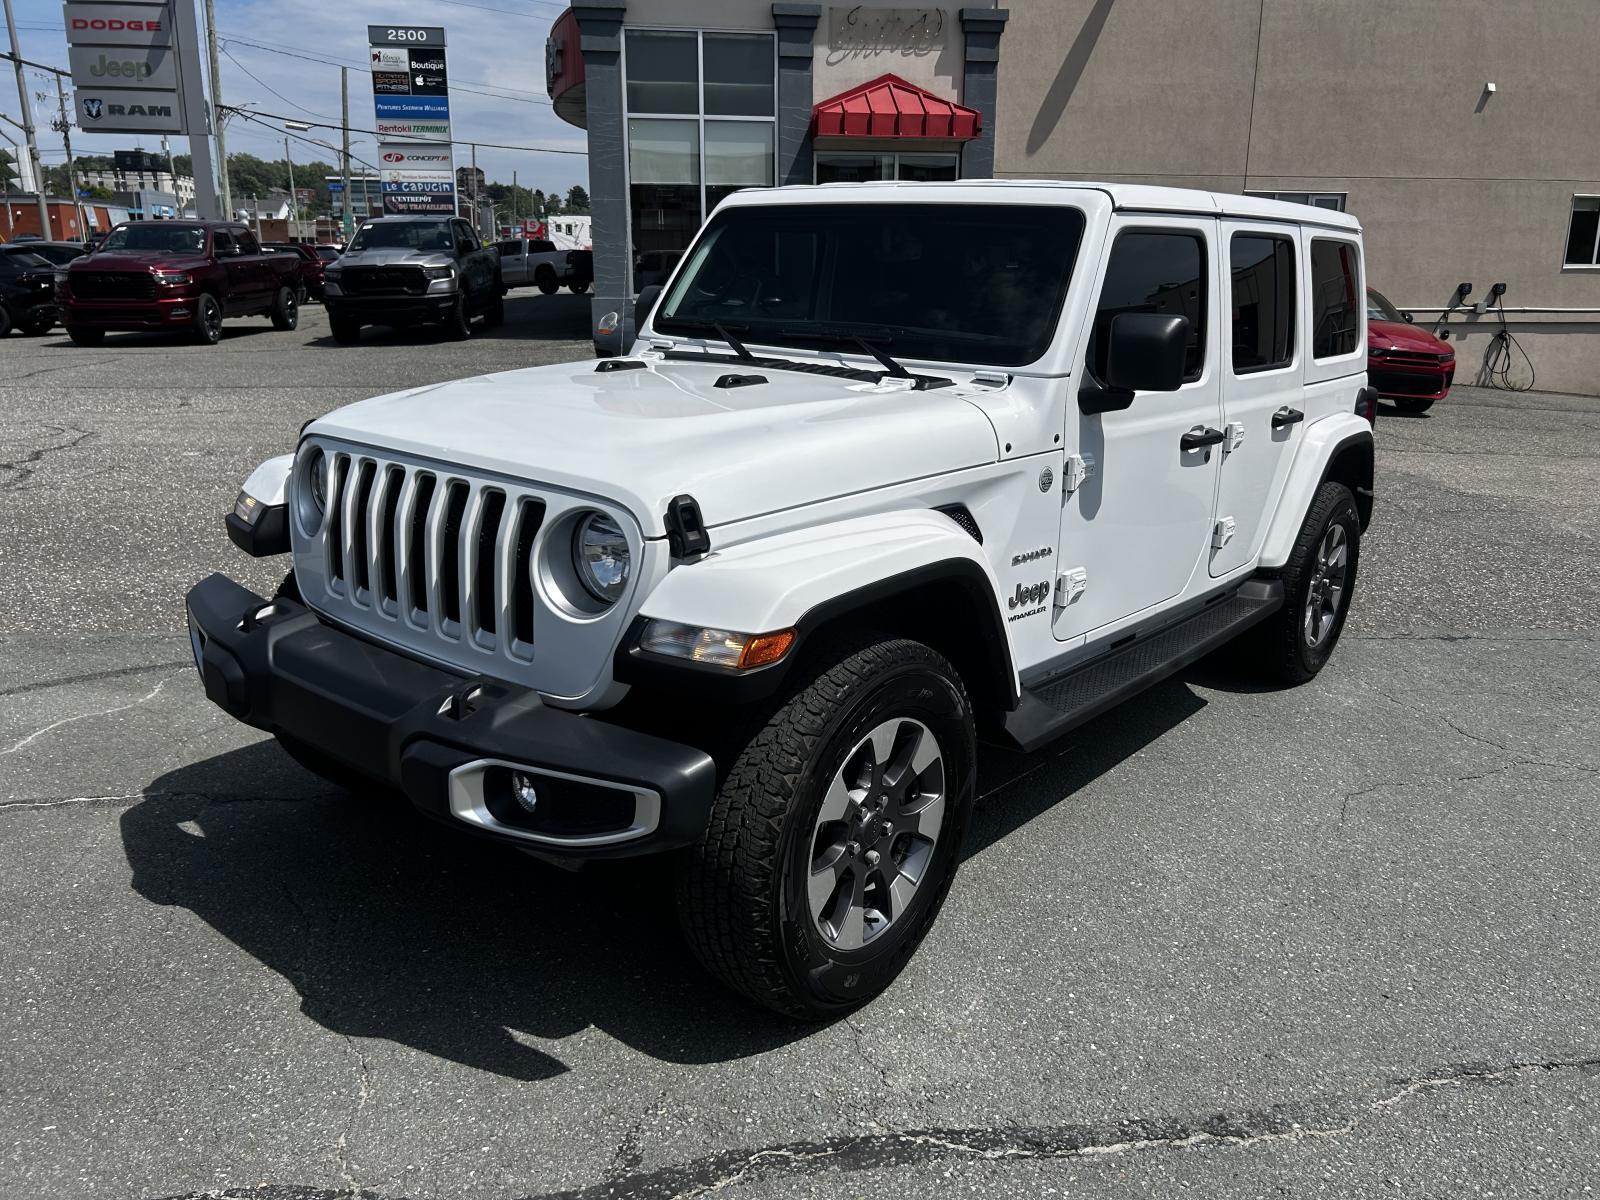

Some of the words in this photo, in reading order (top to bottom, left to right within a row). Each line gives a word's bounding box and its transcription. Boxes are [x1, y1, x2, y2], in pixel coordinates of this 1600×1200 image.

[71, 19, 161, 31] DODGE
[387, 30, 426, 40] 2500
[89, 54, 152, 81] Jeep
[411, 60, 444, 71] Boutique
[108, 104, 171, 116] RAM
[379, 125, 412, 133] Rentokil
[1011, 547, 1052, 566] SAHARA
[1008, 580, 1050, 609] Jeep
[1008, 606, 1047, 623] WRANGLER
